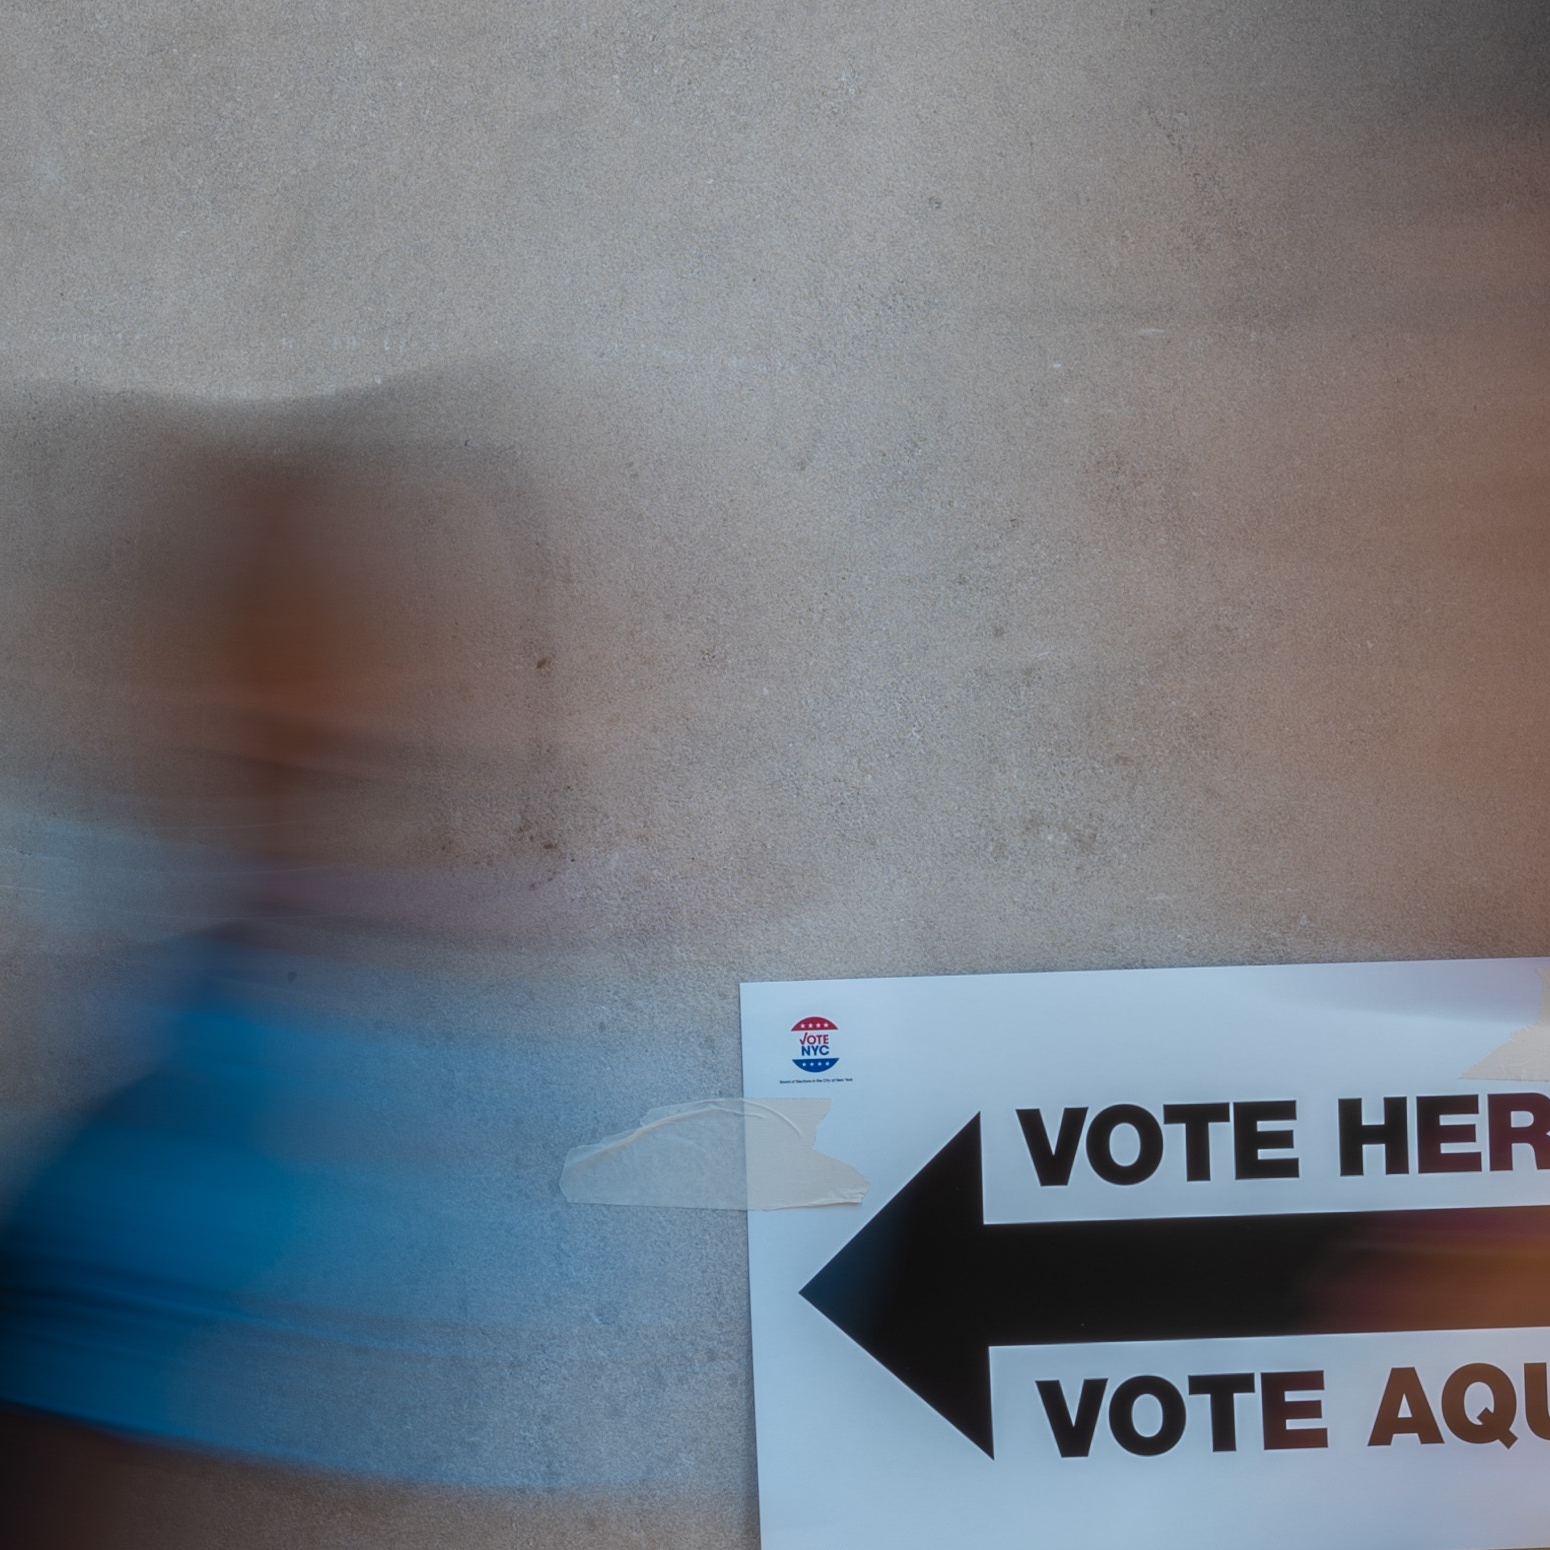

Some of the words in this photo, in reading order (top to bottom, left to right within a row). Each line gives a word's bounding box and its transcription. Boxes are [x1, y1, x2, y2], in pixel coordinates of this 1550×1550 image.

[801, 1045, 830, 1056] NYC
[1016, 1099, 1300, 1187] VOTE
[1035, 1370, 1329, 1459] VOTE
